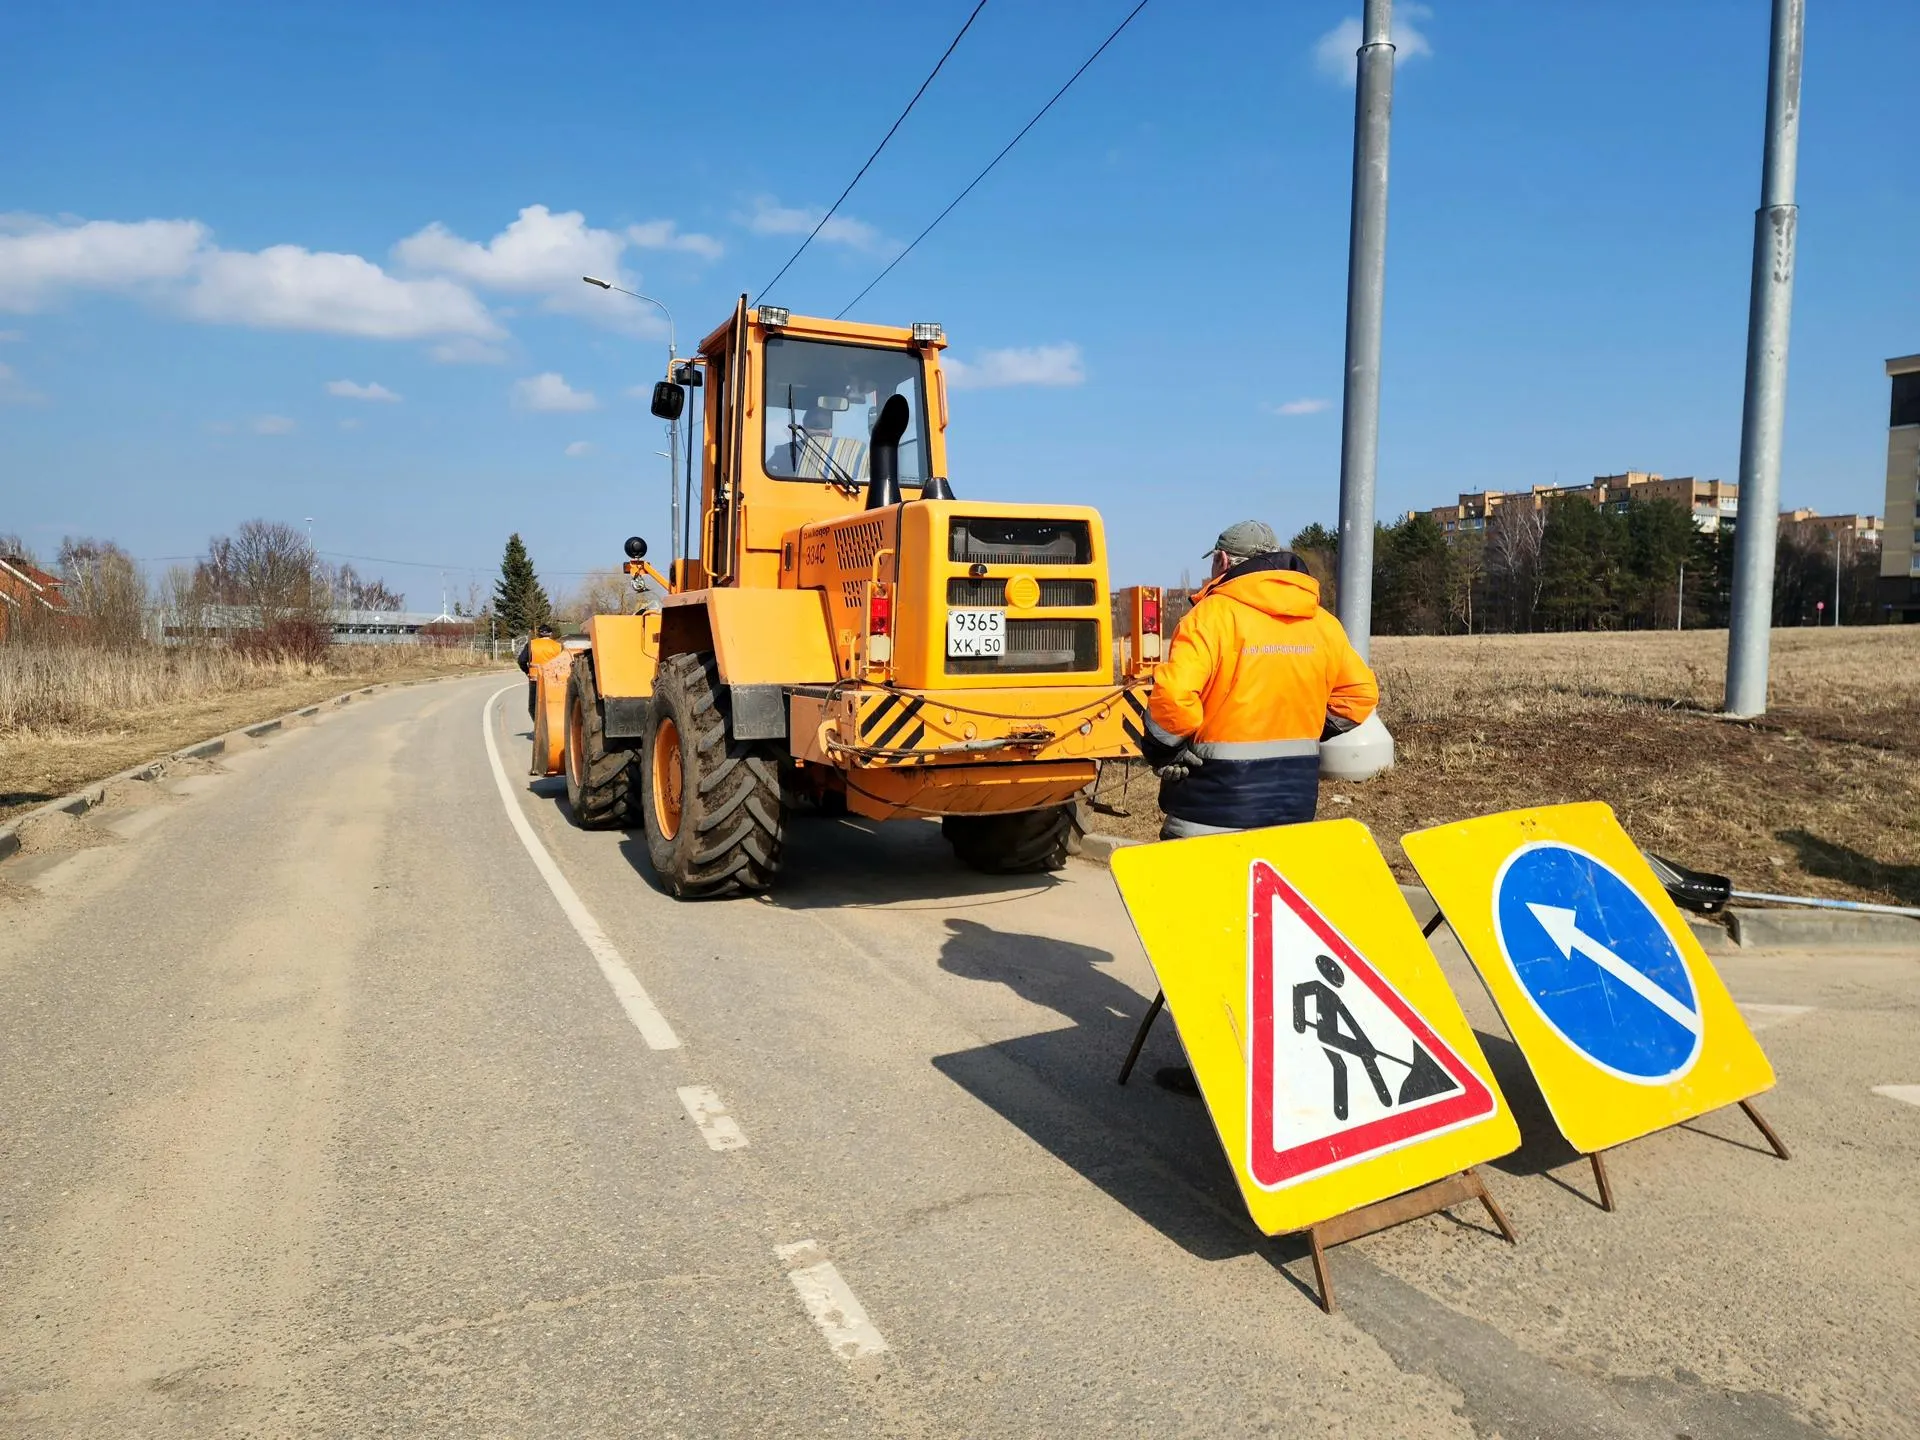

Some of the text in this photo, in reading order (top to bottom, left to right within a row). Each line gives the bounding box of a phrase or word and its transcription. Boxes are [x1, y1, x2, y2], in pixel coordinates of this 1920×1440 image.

[805, 543, 826, 566] 334С
[955, 613, 998, 631] 9365
[953, 638, 1001, 653] ХК 50
